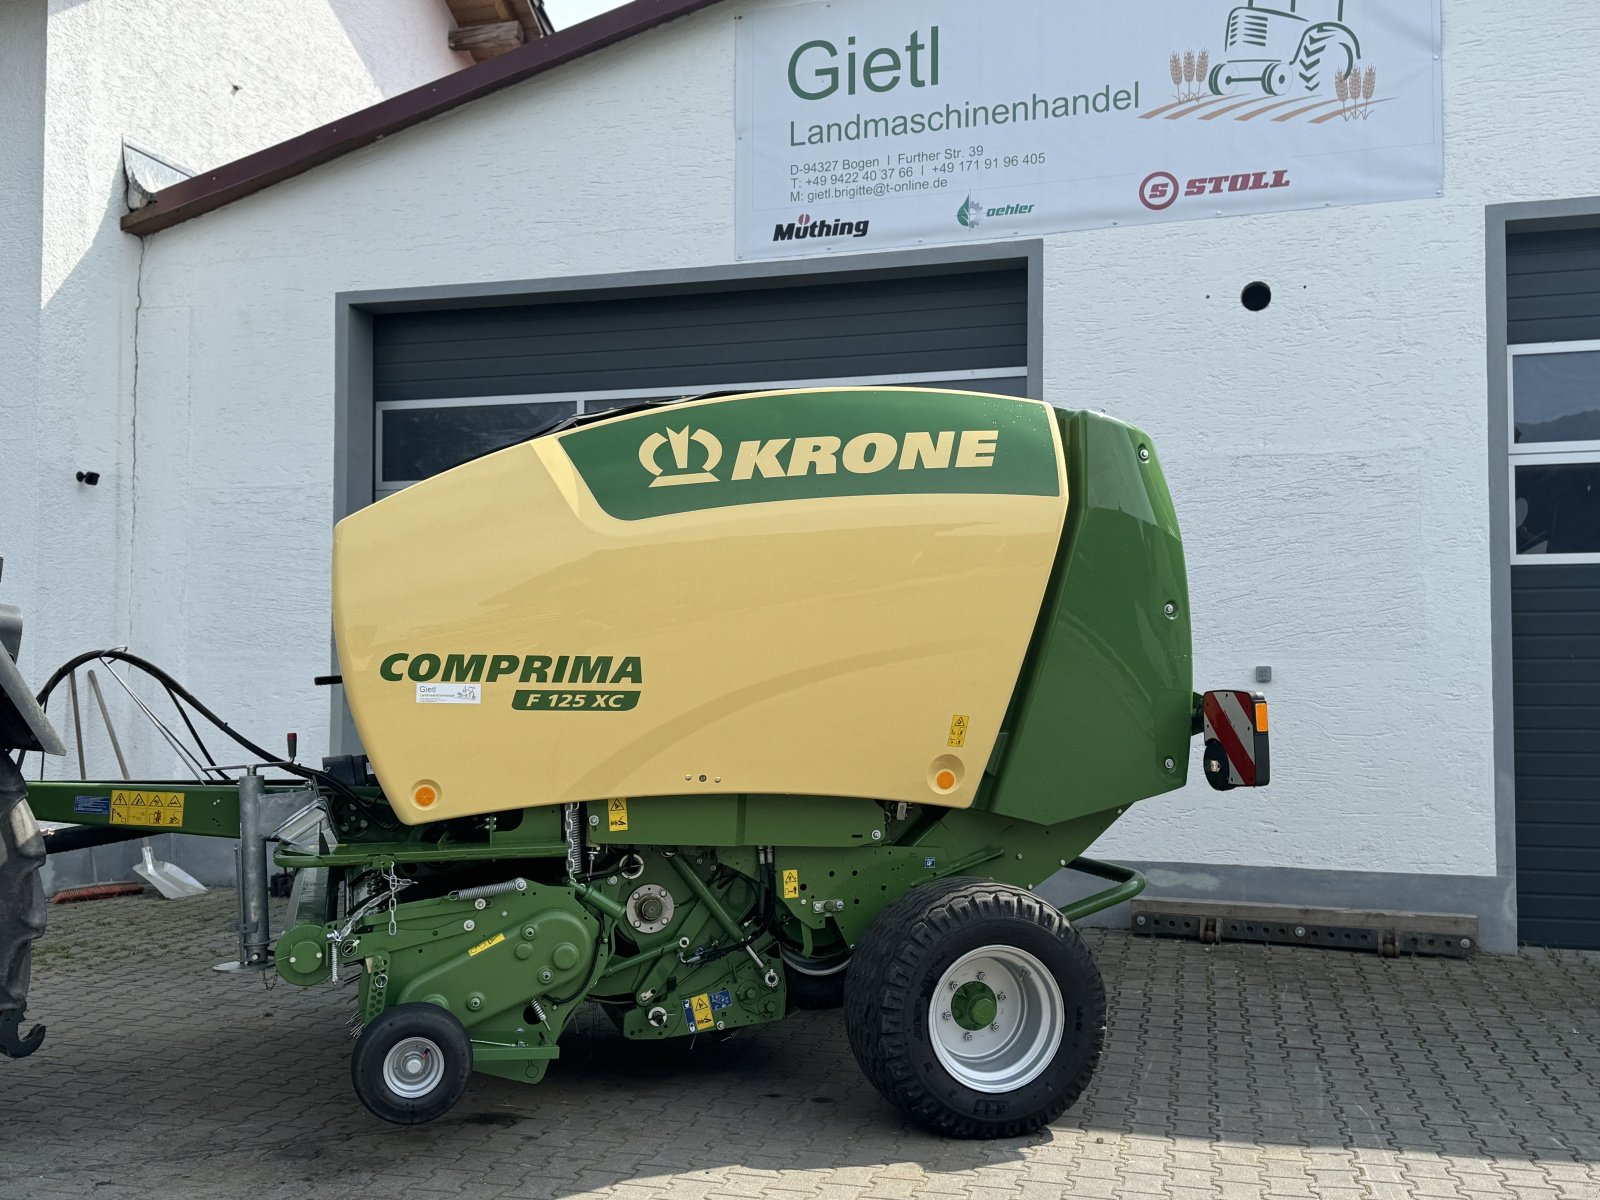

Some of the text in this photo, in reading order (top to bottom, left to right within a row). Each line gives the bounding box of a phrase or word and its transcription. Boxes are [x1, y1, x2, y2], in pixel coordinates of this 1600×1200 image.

[788, 26, 939, 101] Gietl
[790, 82, 1140, 147] Landmaschinenhandel
[790, 160, 839, 175] D-94327
[842, 158, 880, 172] Bogen
[898, 151, 941, 165] Further
[944, 148, 965, 160] Str.
[968, 145, 984, 157] 39
[791, 177, 802, 189] T:
[805, 175, 827, 187] +49
[830, 171, 859, 185] 9422
[862, 170, 877, 182] 40
[880, 168, 895, 180] 37
[898, 166, 914, 179] 66
[931, 162, 955, 174] +49
[959, 159, 980, 172] 171
[984, 157, 999, 170] 91
[1003, 155, 1019, 168] 96
[1022, 152, 1046, 165] 405
[790, 177, 948, 204] M: gietl.brigitte@t-online.de
[1184, 169, 1291, 197] STOLL
[985, 203, 1035, 217] oehler
[772, 213, 870, 242] Müthing
[730, 429, 1000, 481] KRONE
[379, 652, 643, 684] COMPRIMA
[526, 693, 625, 708] F 125 XC
